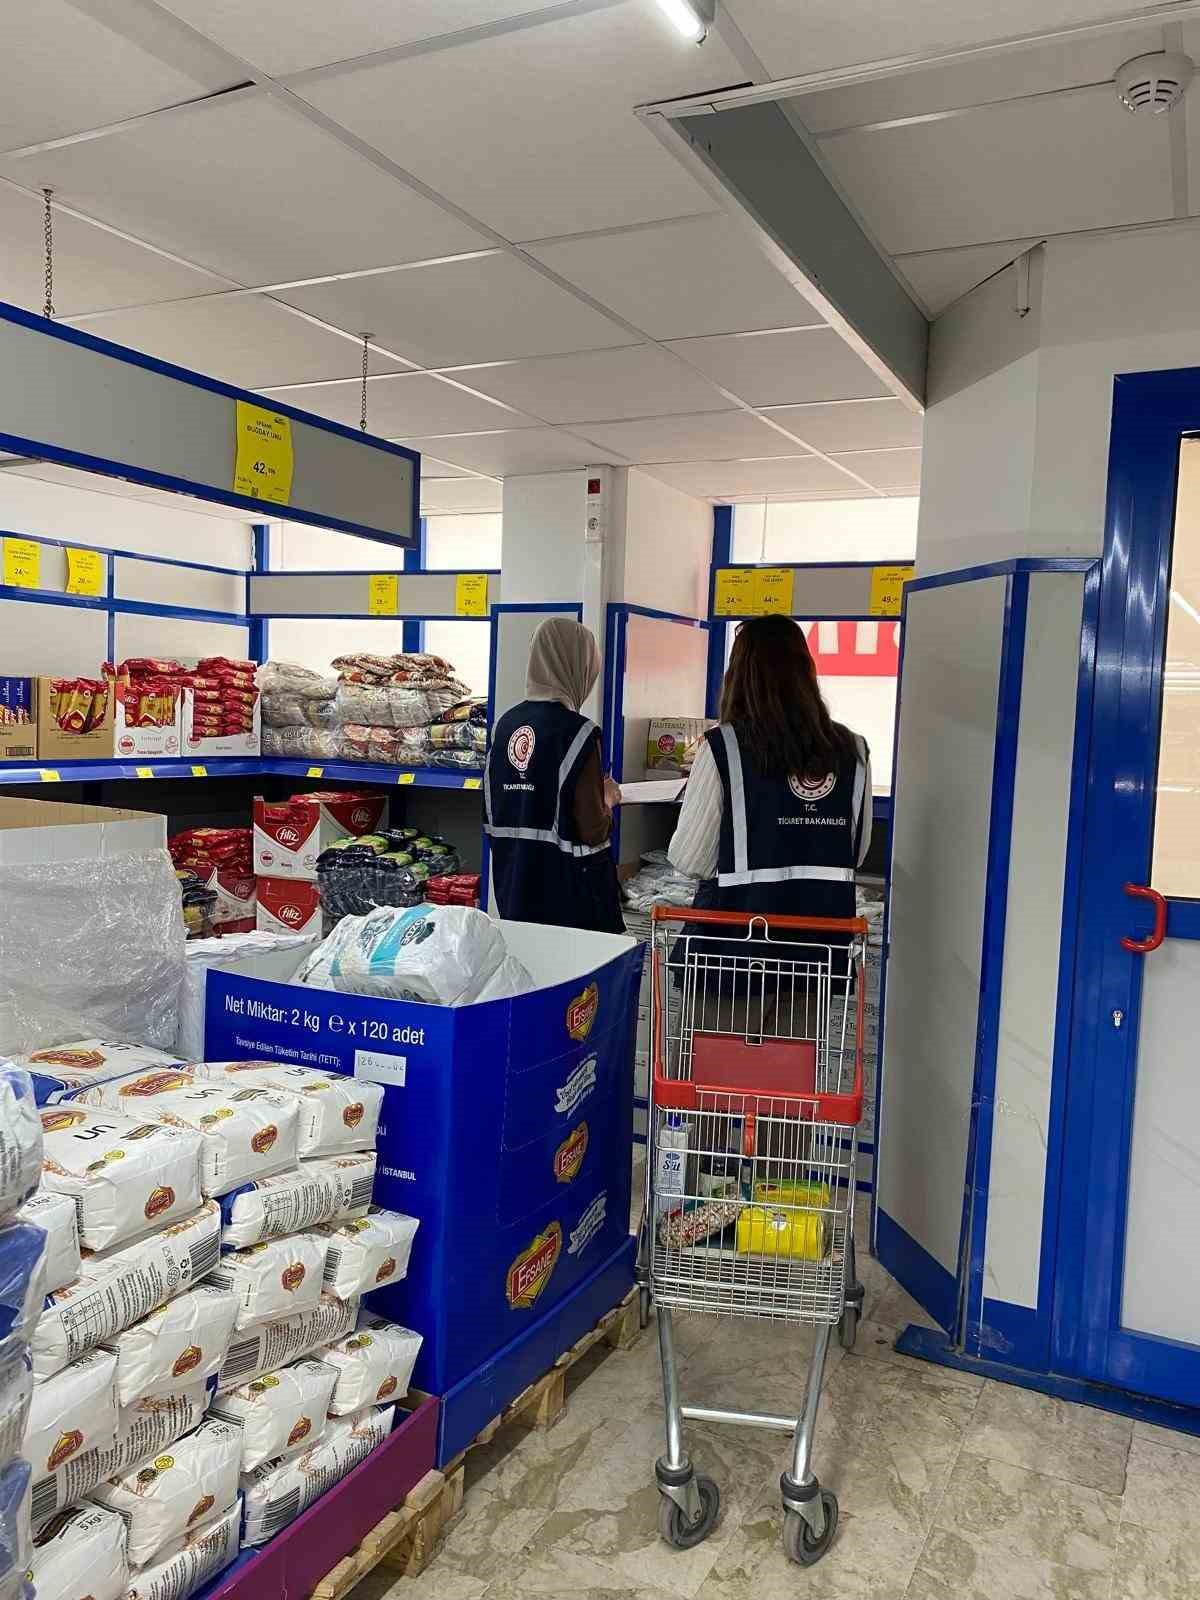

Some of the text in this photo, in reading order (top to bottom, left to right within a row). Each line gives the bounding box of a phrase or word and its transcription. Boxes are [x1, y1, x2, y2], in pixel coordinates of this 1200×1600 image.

[777, 814, 847, 826] TİCARET BAKANLIĞI
[279, 827, 298, 840] filiz
[281, 907, 300, 918] filiz
[225, 994, 244, 1015] Net
[247, 999, 288, 1024] Miktar:
[291, 1009, 300, 1026] 2
[304, 1011, 320, 1032] kg
[347, 1021, 356, 1036] x
[361, 1020, 388, 1040] 120
[392, 1027, 425, 1046] adet
[235, 1036, 256, 1050] Tavsiye
[382, 1165, 417, 1181] İSTANBUL
[518, 1248, 552, 1293] EFSANE
